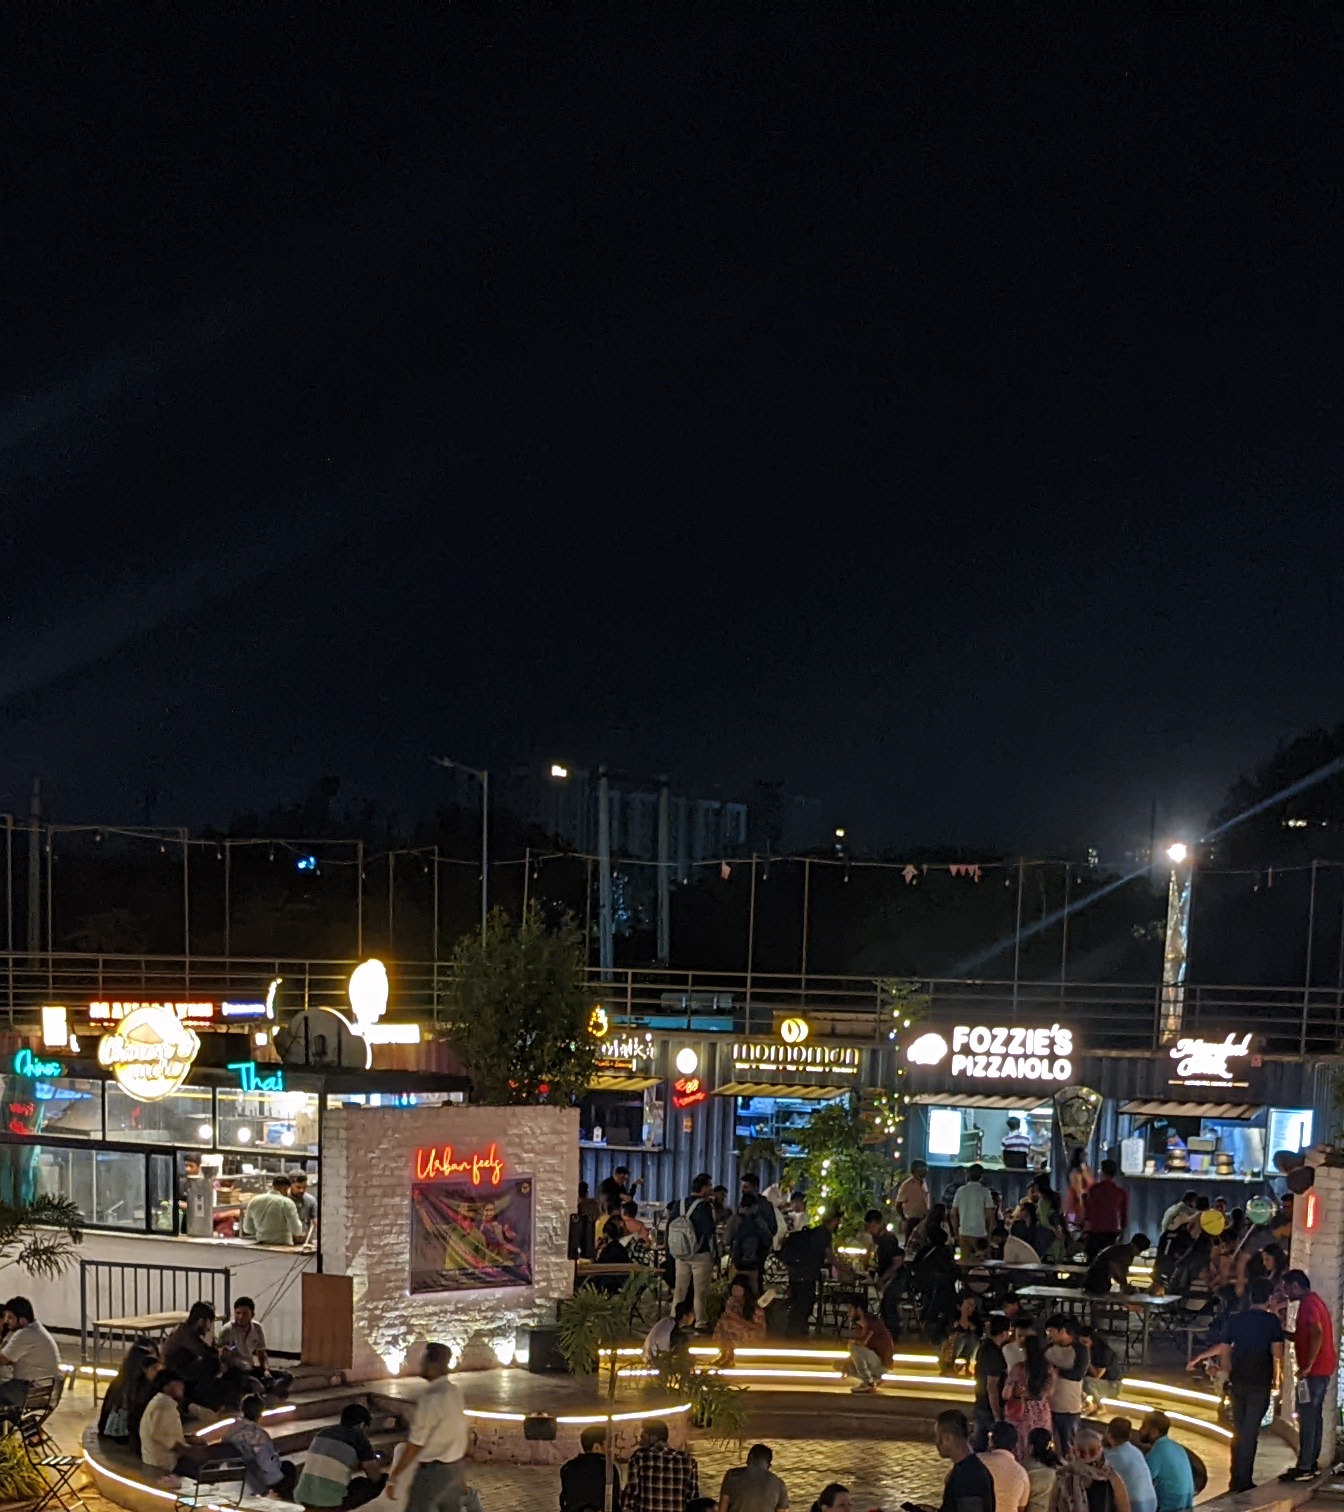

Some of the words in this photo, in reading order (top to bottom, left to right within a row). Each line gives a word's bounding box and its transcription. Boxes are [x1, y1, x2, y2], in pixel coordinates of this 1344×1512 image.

[952, 1023, 1073, 1056] FOZZIE'S
[227, 1061, 284, 1092] Thai
[951, 1054, 1072, 1080] PIZZAIOLO
[417, 1146, 471, 1179] Urban
[472, 1143, 504, 1185] feels
